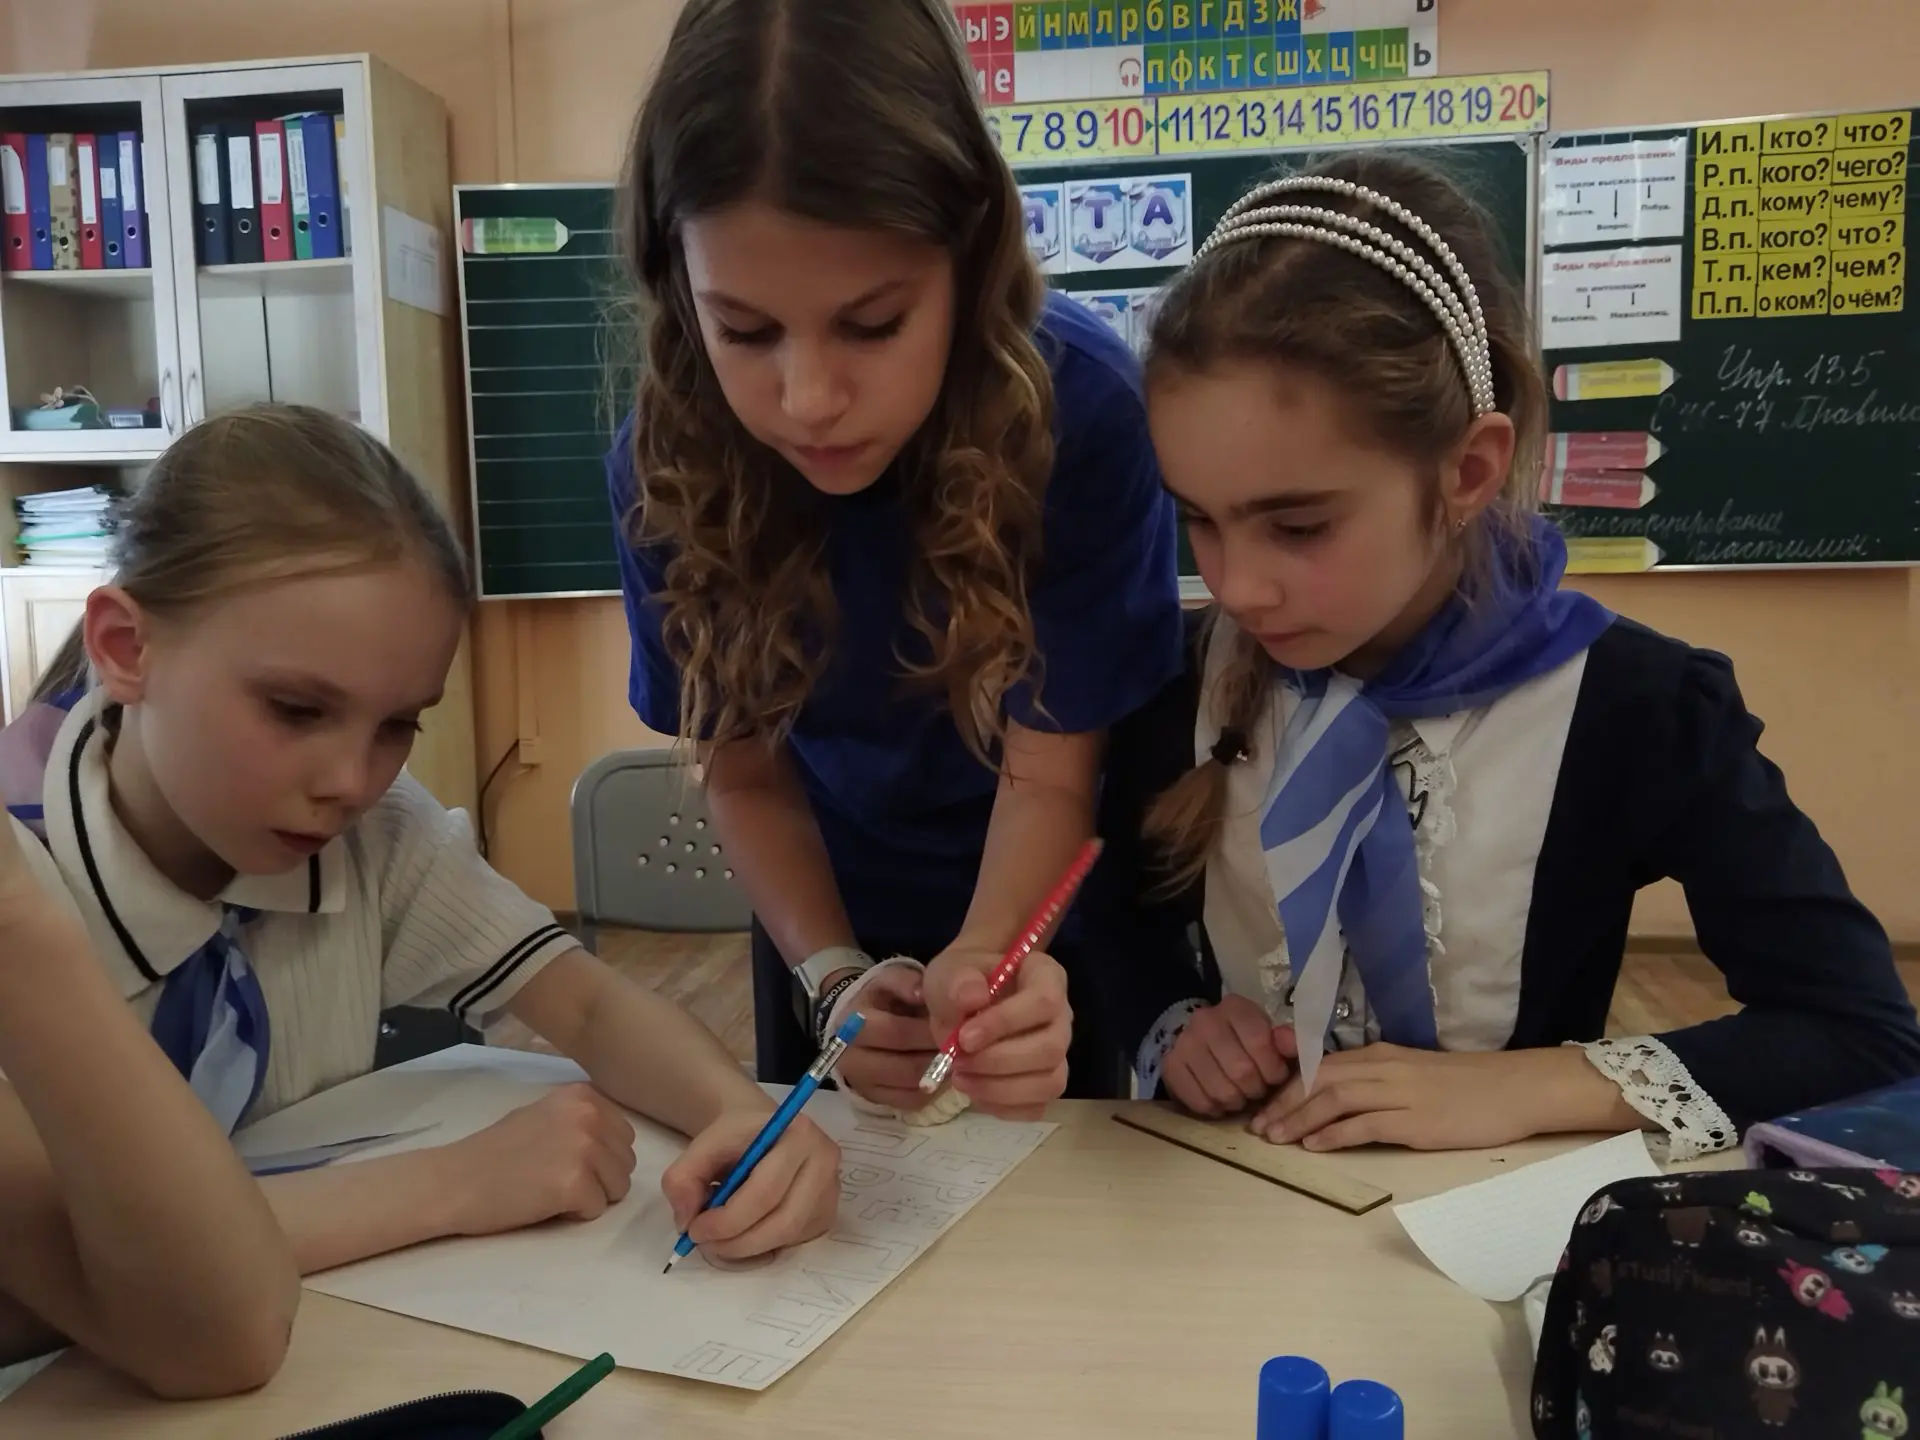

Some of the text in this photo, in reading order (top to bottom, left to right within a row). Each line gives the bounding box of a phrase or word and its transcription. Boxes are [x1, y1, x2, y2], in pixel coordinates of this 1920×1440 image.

[1011, 113, 1034, 152] 7
[1044, 112, 1066, 150] 8
[1076, 110, 1098, 149] 9
[1104, 107, 1144, 147] 10
[1169, 106, 1194, 142] 11
[1200, 104, 1231, 142] 12
[1235, 101, 1266, 139] 13
[1273, 99, 1305, 136] 14
[1311, 96, 1342, 132] 15
[1350, 94, 1380, 130] 16
[1386, 92, 1417, 129] 17
[1423, 88, 1454, 126] 18
[1460, 86, 1493, 123] 19
[1500, 83, 1536, 122] 20
[1770, 122, 1829, 149] кто?
[1844, 116, 1904, 144] что?
[1761, 156, 1830, 184] кого?
[1836, 150, 1906, 178] чего?
[1761, 188, 1830, 216] кому?
[1833, 183, 1904, 212] чему?
[1760, 222, 1828, 249] кого?
[1838, 219, 1897, 246] что?
[1762, 255, 1826, 281] кем?
[1835, 251, 1901, 279] чем?
[1804, 350, 1886, 387] 135
